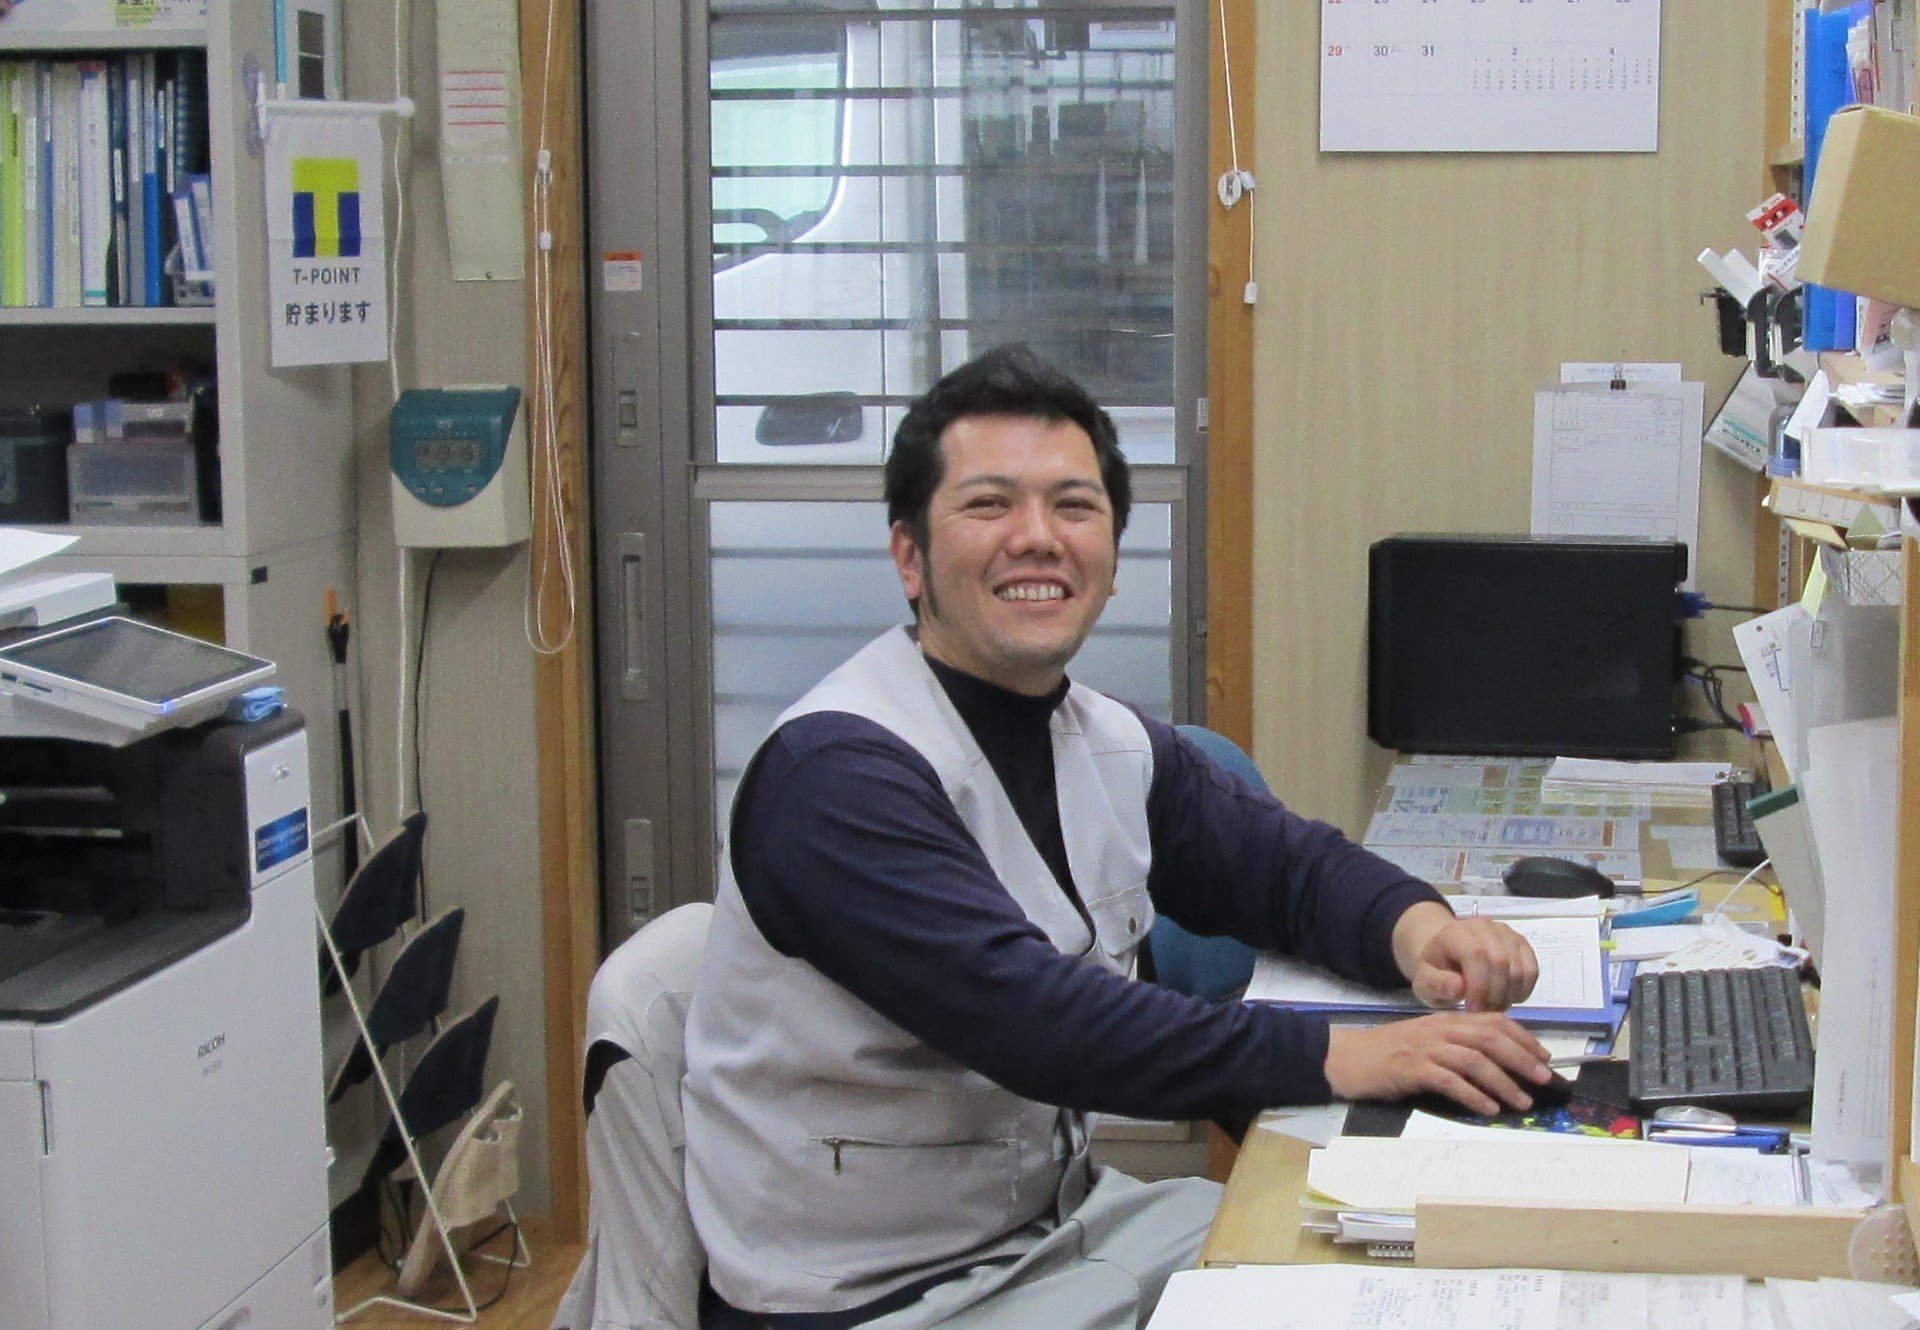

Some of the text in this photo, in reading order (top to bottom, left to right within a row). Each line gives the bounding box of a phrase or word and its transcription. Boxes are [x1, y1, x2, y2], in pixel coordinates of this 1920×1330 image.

[1327, 45, 1343, 57] 29
[1373, 45, 1389, 57] 30
[1421, 45, 1435, 57] 31
[1511, 47, 1518, 56] 2
[1609, 47, 1615, 56] 4
[292, 157, 361, 258] T
[293, 267, 361, 285] T-POINT
[285, 301, 371, 326] 貯まります
